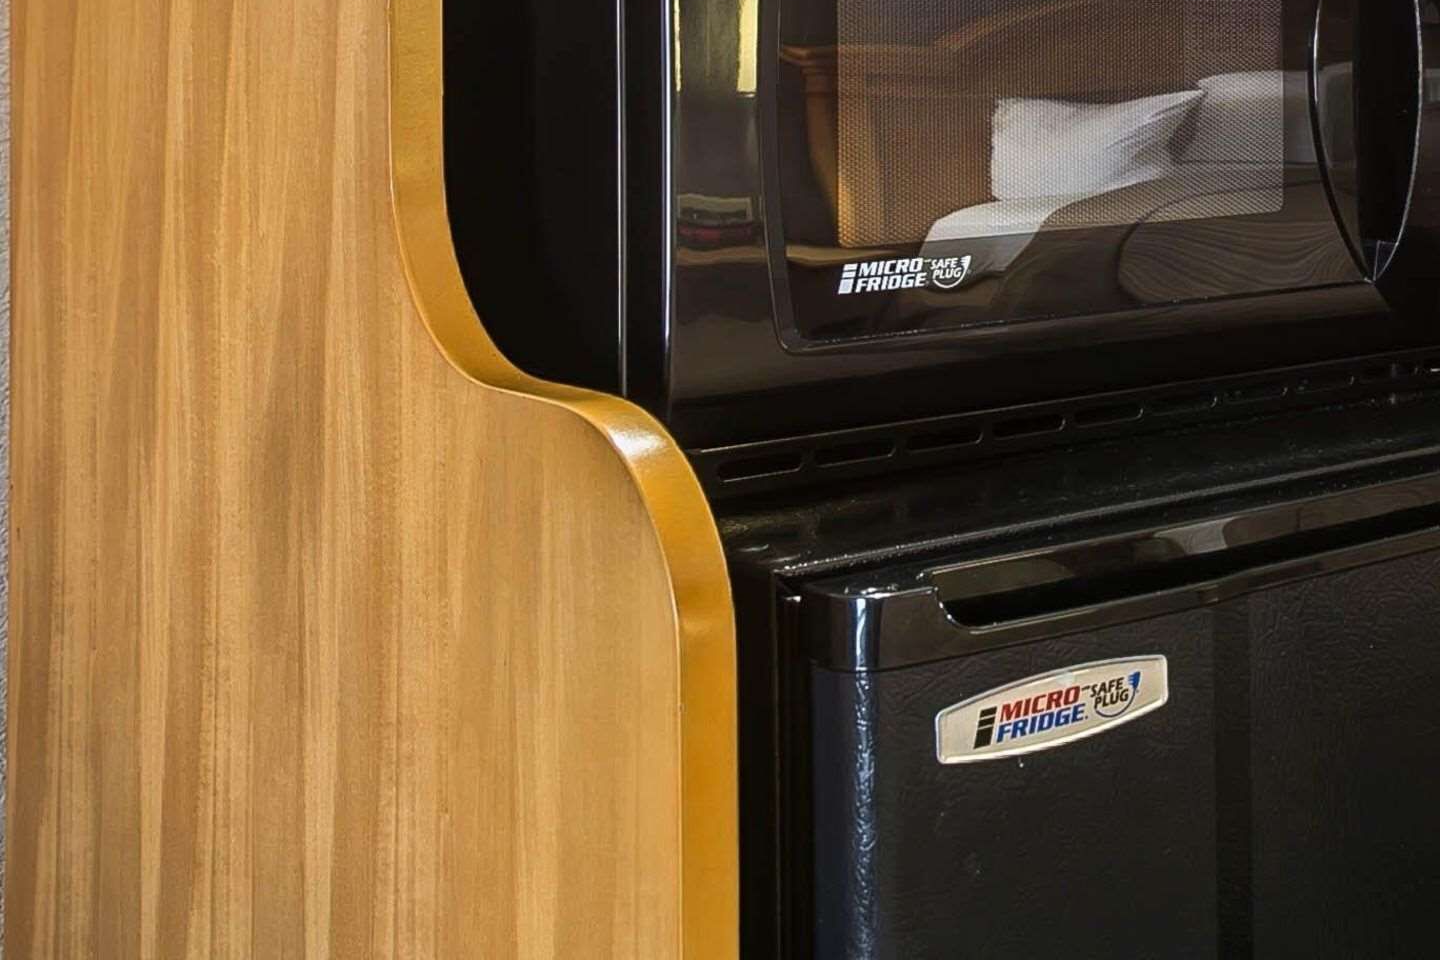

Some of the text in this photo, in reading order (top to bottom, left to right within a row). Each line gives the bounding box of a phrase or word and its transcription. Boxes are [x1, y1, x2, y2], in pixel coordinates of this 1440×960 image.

[858, 257, 924, 277] MICRO
[930, 257, 958, 270] SAFE
[932, 267, 962, 280] PLUG
[855, 272, 928, 293] FRIDGE
[1090, 677, 1124, 698] SAFE
[1000, 685, 1081, 722] MICRO
[1094, 692, 1130, 709] PLUG
[996, 703, 1086, 743] FRIDGE
